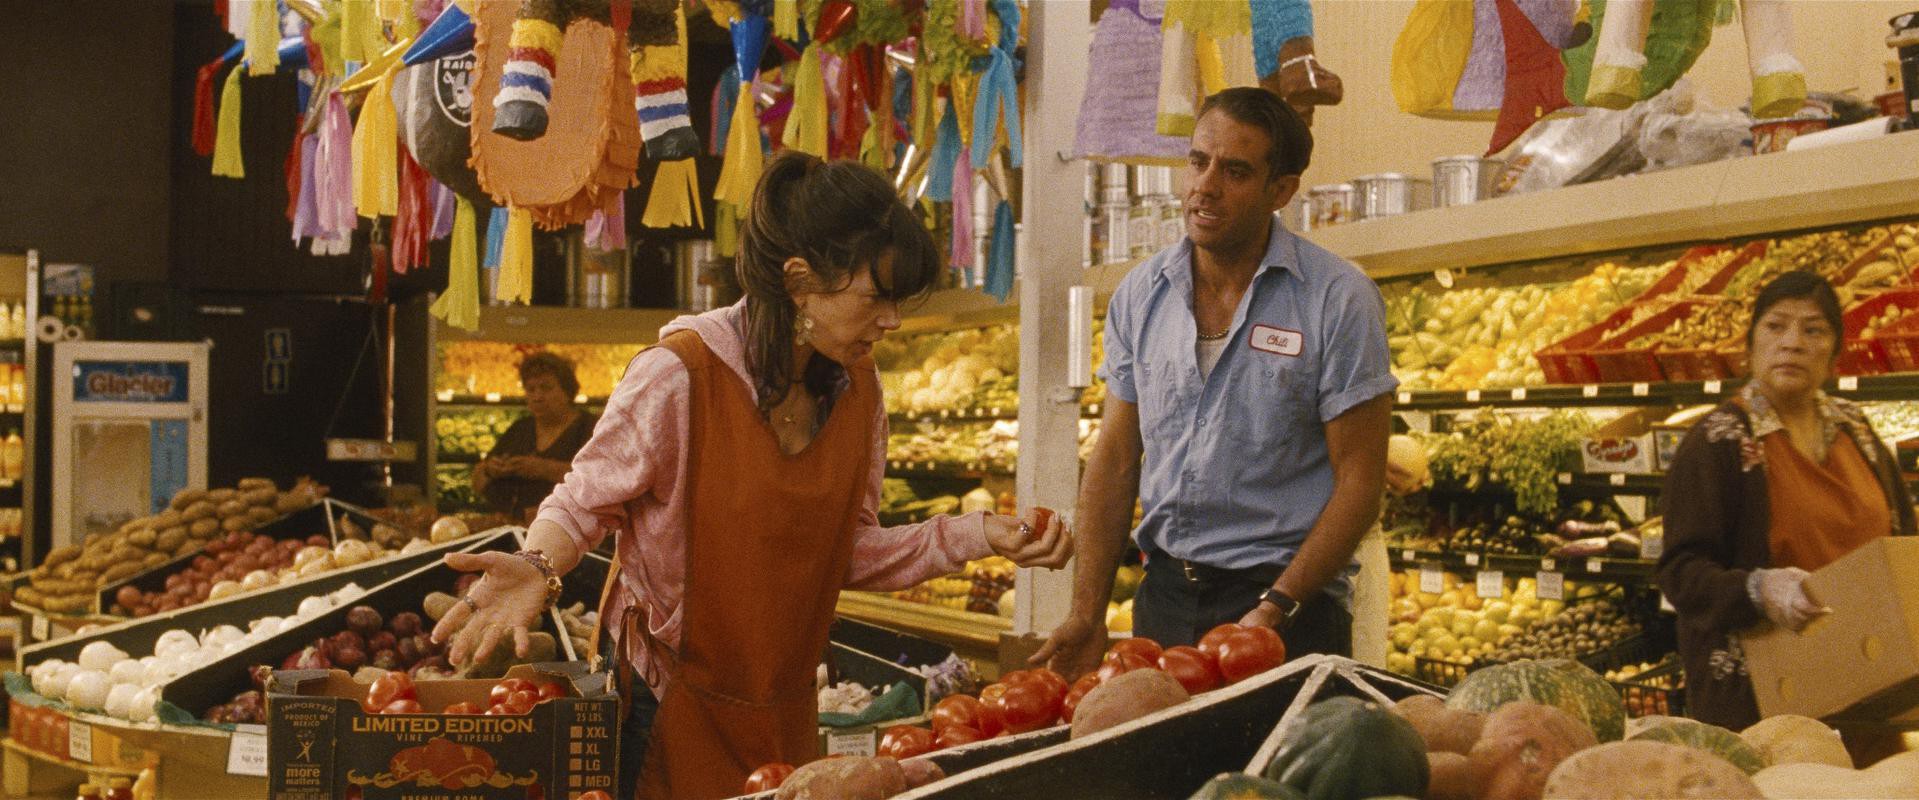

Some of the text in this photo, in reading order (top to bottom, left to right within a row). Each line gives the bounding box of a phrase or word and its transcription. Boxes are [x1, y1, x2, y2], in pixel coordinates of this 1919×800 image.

[443, 60, 473, 70] RAID
[281, 702, 336, 713] IMPORTED
[574, 702, 589, 712] NET
[576, 712, 587, 722] 25
[352, 717, 533, 733] LIMITED EDITION
[586, 726, 609, 739] XXL
[397, 734, 503, 743] VINE RIPENED
[585, 743, 601, 754] XL
[585, 760, 601, 771] LG
[287, 768, 320, 777] more
[585, 775, 611, 787] MED
